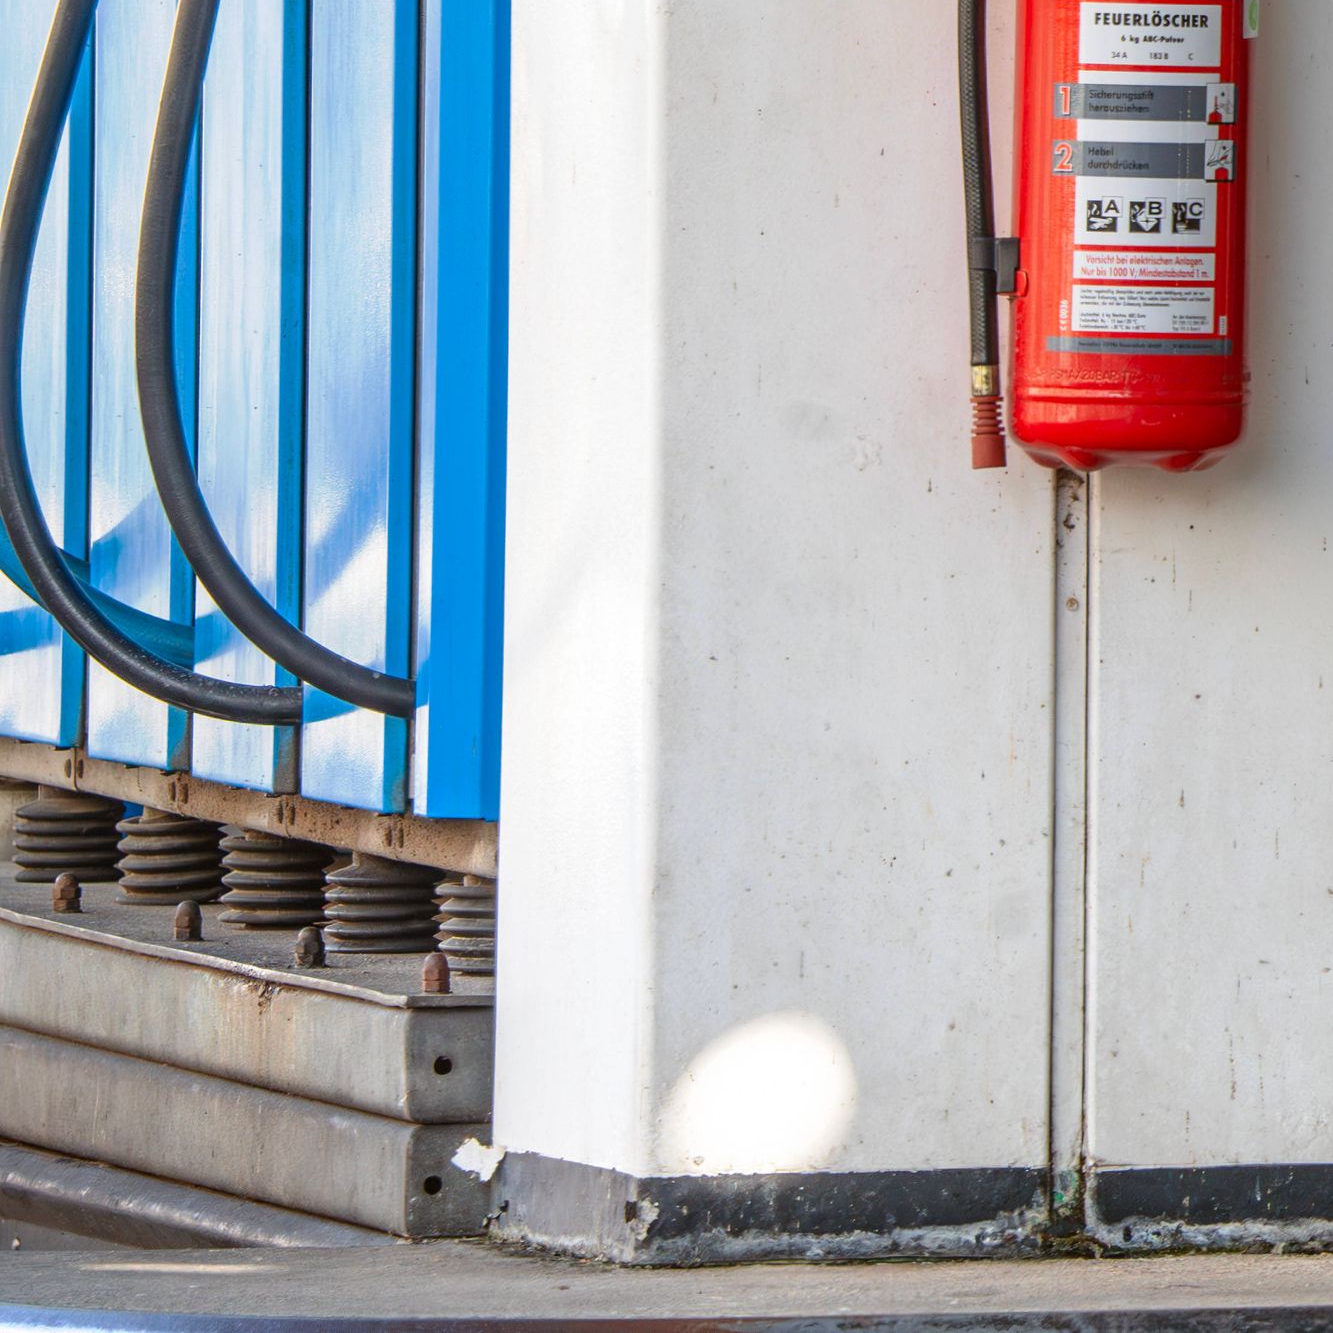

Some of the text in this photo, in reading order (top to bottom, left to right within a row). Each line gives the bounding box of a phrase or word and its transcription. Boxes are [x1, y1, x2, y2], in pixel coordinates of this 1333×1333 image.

[1094, 10, 1209, 28] FEUERLÖSCHER
[1129, 34, 1140, 44] kg
[1142, 35, 1185, 43] ABC-Pulver
[1187, 52, 1194, 61] C
[1060, 85, 1154, 115] 1 Sicherungsstift
[1088, 102, 1150, 113] herausziehen
[1053, 141, 1114, 172] 2 Hebel
[1087, 159, 1150, 170] durchdrücken
[1104, 199, 1203, 216] A B C
[1086, 255, 1115, 264] Vorsicht
[1116, 255, 1128, 264] bei
[1129, 256, 1173, 265] elektrischen
[1081, 267, 1094, 276] Nur
[1096, 267, 1107, 276] bis
[1109, 267, 1128, 276] 1000
